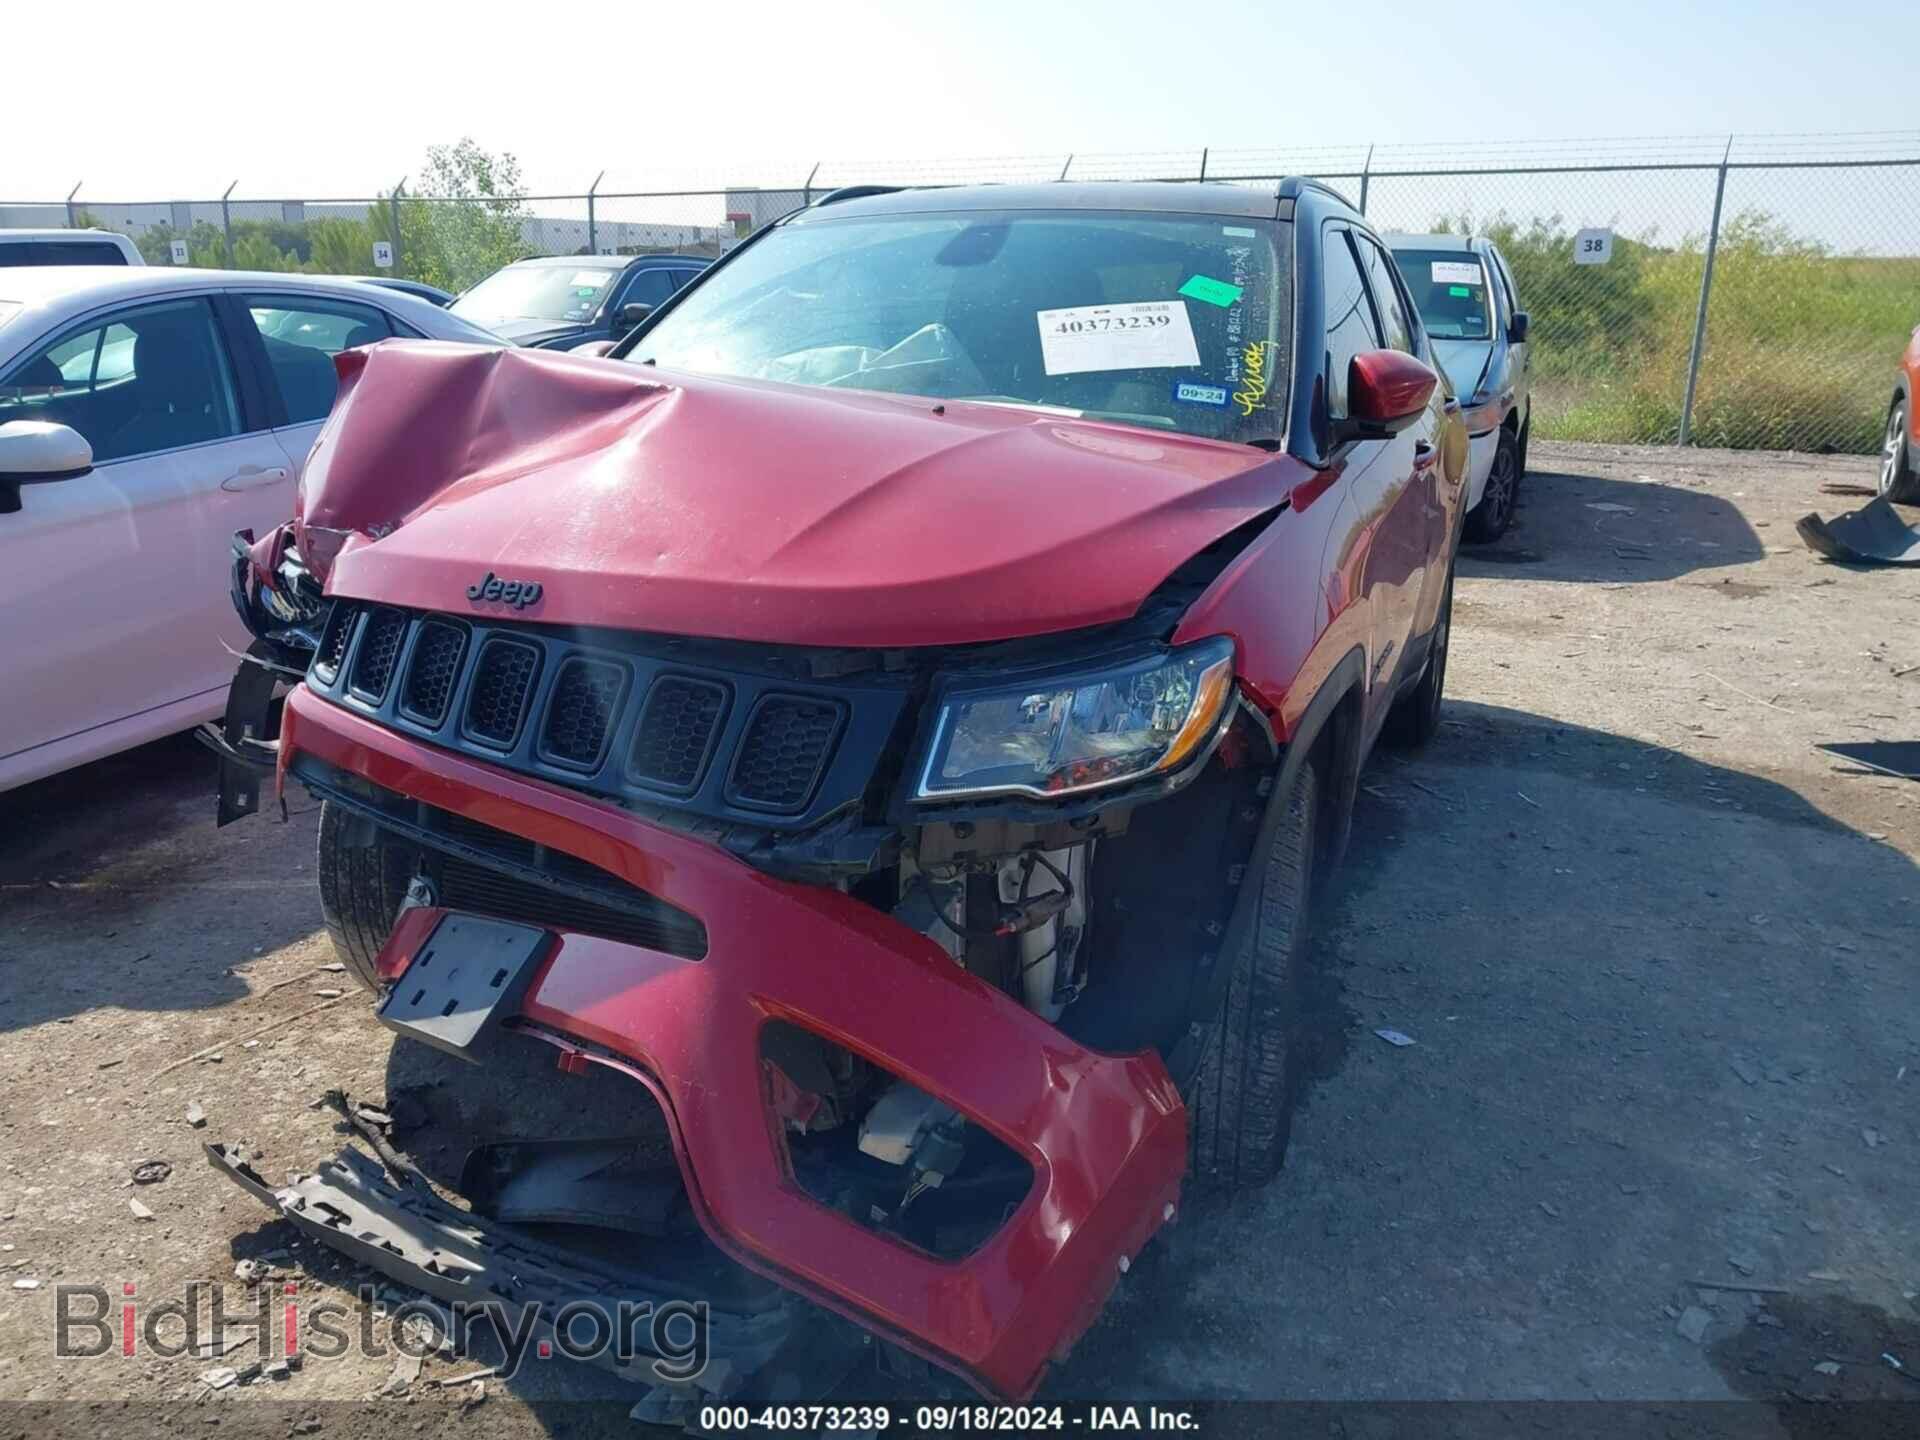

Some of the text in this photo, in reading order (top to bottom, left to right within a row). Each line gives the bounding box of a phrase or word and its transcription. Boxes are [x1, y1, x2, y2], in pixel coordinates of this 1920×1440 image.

[1584, 239, 1603, 252] 38
[377, 249, 388, 260] 34
[1055, 314, 1172, 335] 40373239
[467, 570, 544, 610] Jeep
